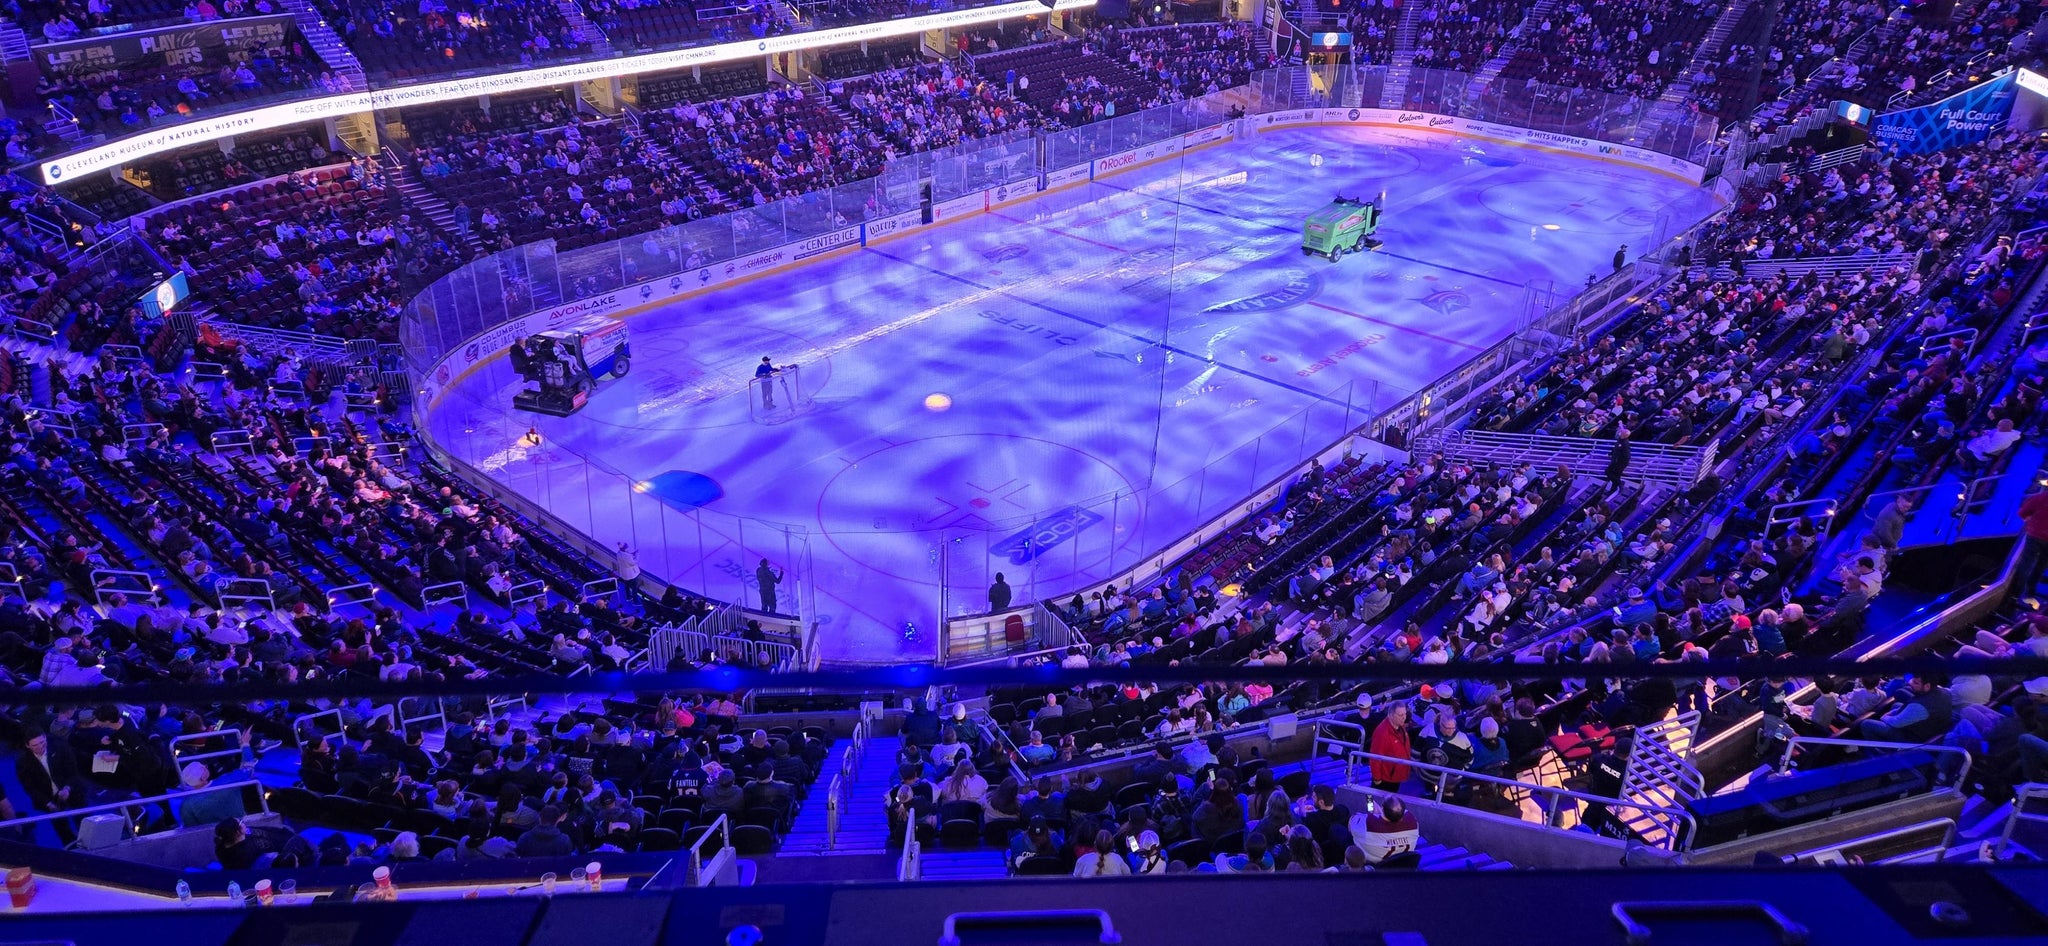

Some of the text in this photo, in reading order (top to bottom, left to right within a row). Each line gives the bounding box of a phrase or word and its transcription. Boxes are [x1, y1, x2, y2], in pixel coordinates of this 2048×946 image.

[221, 23, 283, 40] LET EM
[834, 30, 858, 38] NATURAL
[859, 26, 882, 35] HISTORY
[140, 33, 175, 54] PLAY
[47, 45, 114, 65] LET EM
[165, 47, 203, 66] OFFS
[295, 105, 316, 116] FACE
[316, 102, 333, 113] OFF
[333, 99, 357, 110] WITH
[358, 93, 395, 105] ANCIENT
[439, 81, 480, 95] FEARSOME
[542, 69, 571, 81] DISTANT
[1398, 113, 1424, 123] Culver's
[1429, 116, 1454, 127] Culver's
[1940, 108, 2002, 123] Full Court
[1877, 124, 1919, 135] COMCAST
[1946, 120, 1989, 132] Power
[1534, 132, 1550, 140] HITS
[1551, 134, 1581, 145] HAPPEN
[1874, 130, 1917, 142] BUSINESS
[65, 117, 256, 172] CLEVELAND MUSEUM of NATURAL HISTORY
[1107, 152, 1137, 170] Rocket
[806, 233, 840, 250] CENTER
[842, 228, 855, 240] ICE
[481, 320, 526, 345] COLUMBUS
[977, 310, 1080, 346] CLIFFS
[482, 340, 498, 355] BLUE
[1600, 763, 1621, 779] POLICE
[675, 779, 699, 788] FANTILLI
[1385, 837, 1409, 846] MONSTERS
